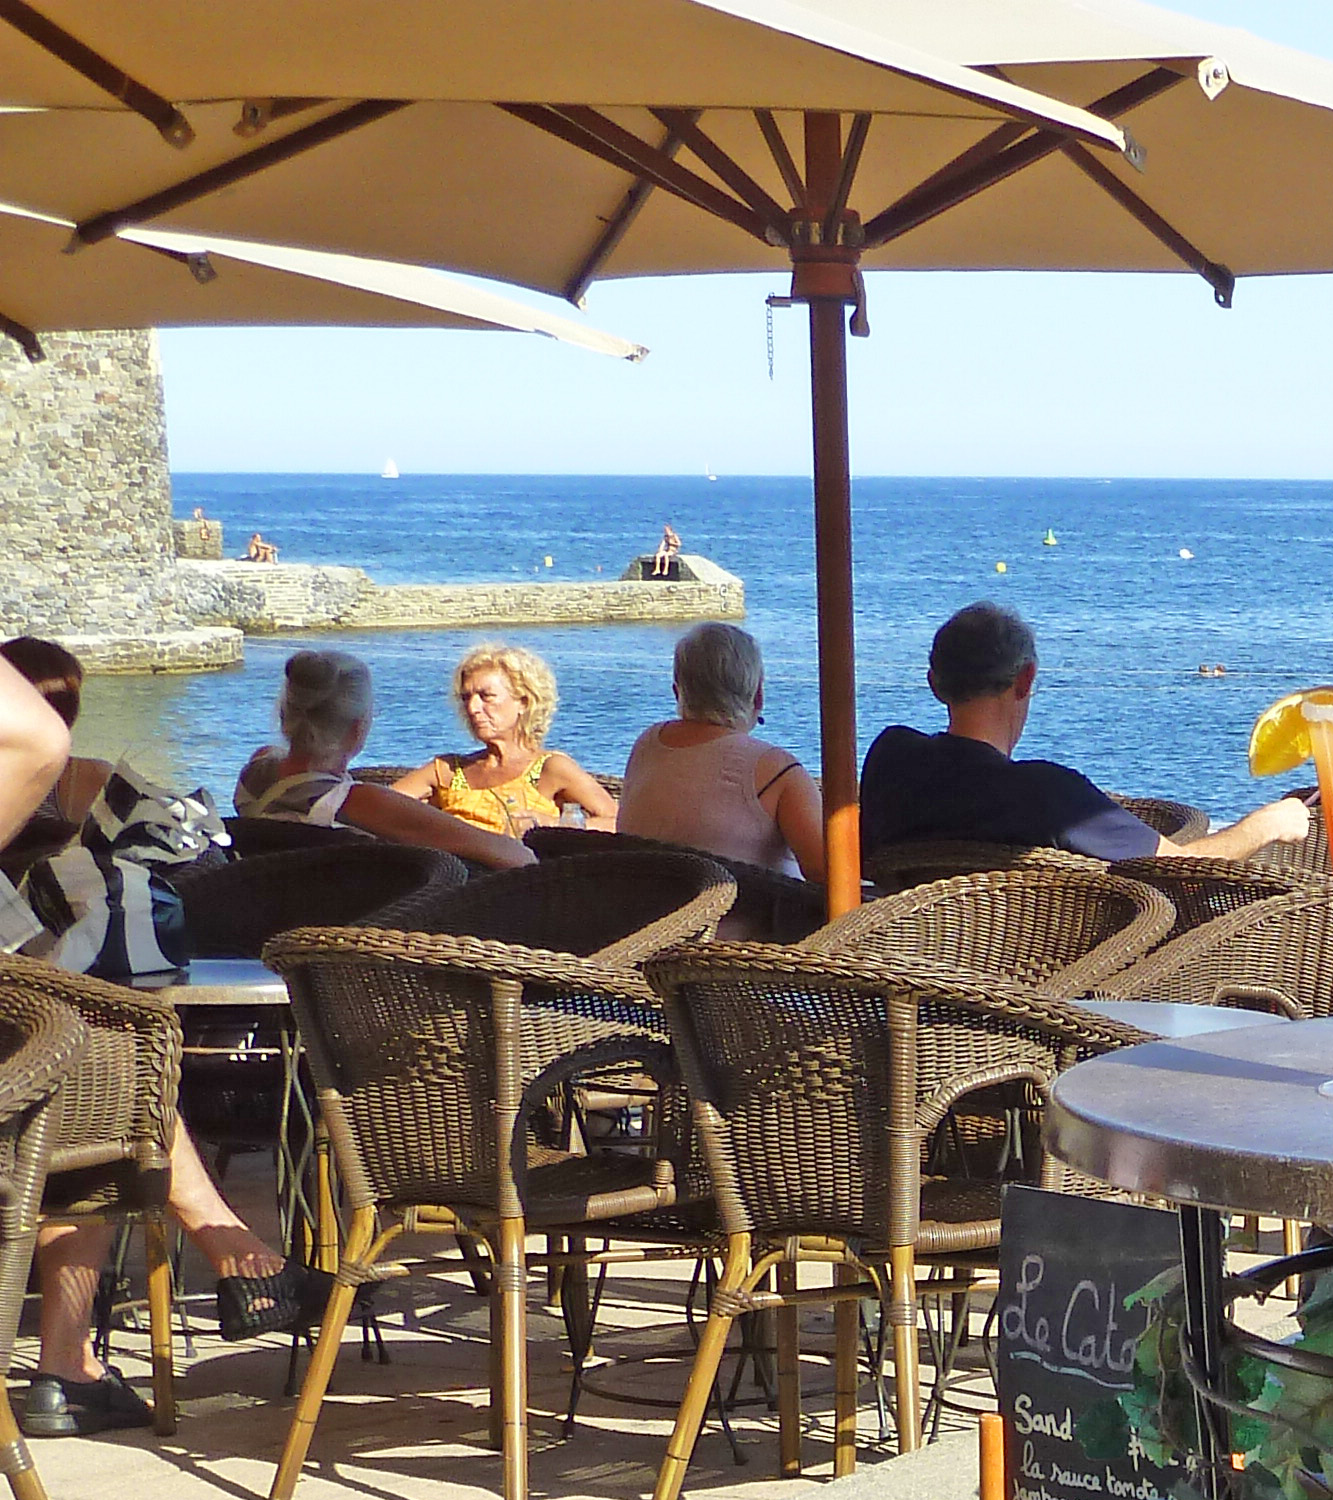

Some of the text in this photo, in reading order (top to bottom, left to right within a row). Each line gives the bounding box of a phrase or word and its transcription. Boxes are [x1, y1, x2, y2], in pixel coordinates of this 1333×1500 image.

[1062, 1279, 1138, 1373] Cata
[1021, 1439, 1046, 1480] la
[1050, 1462, 1102, 1492] sauce
